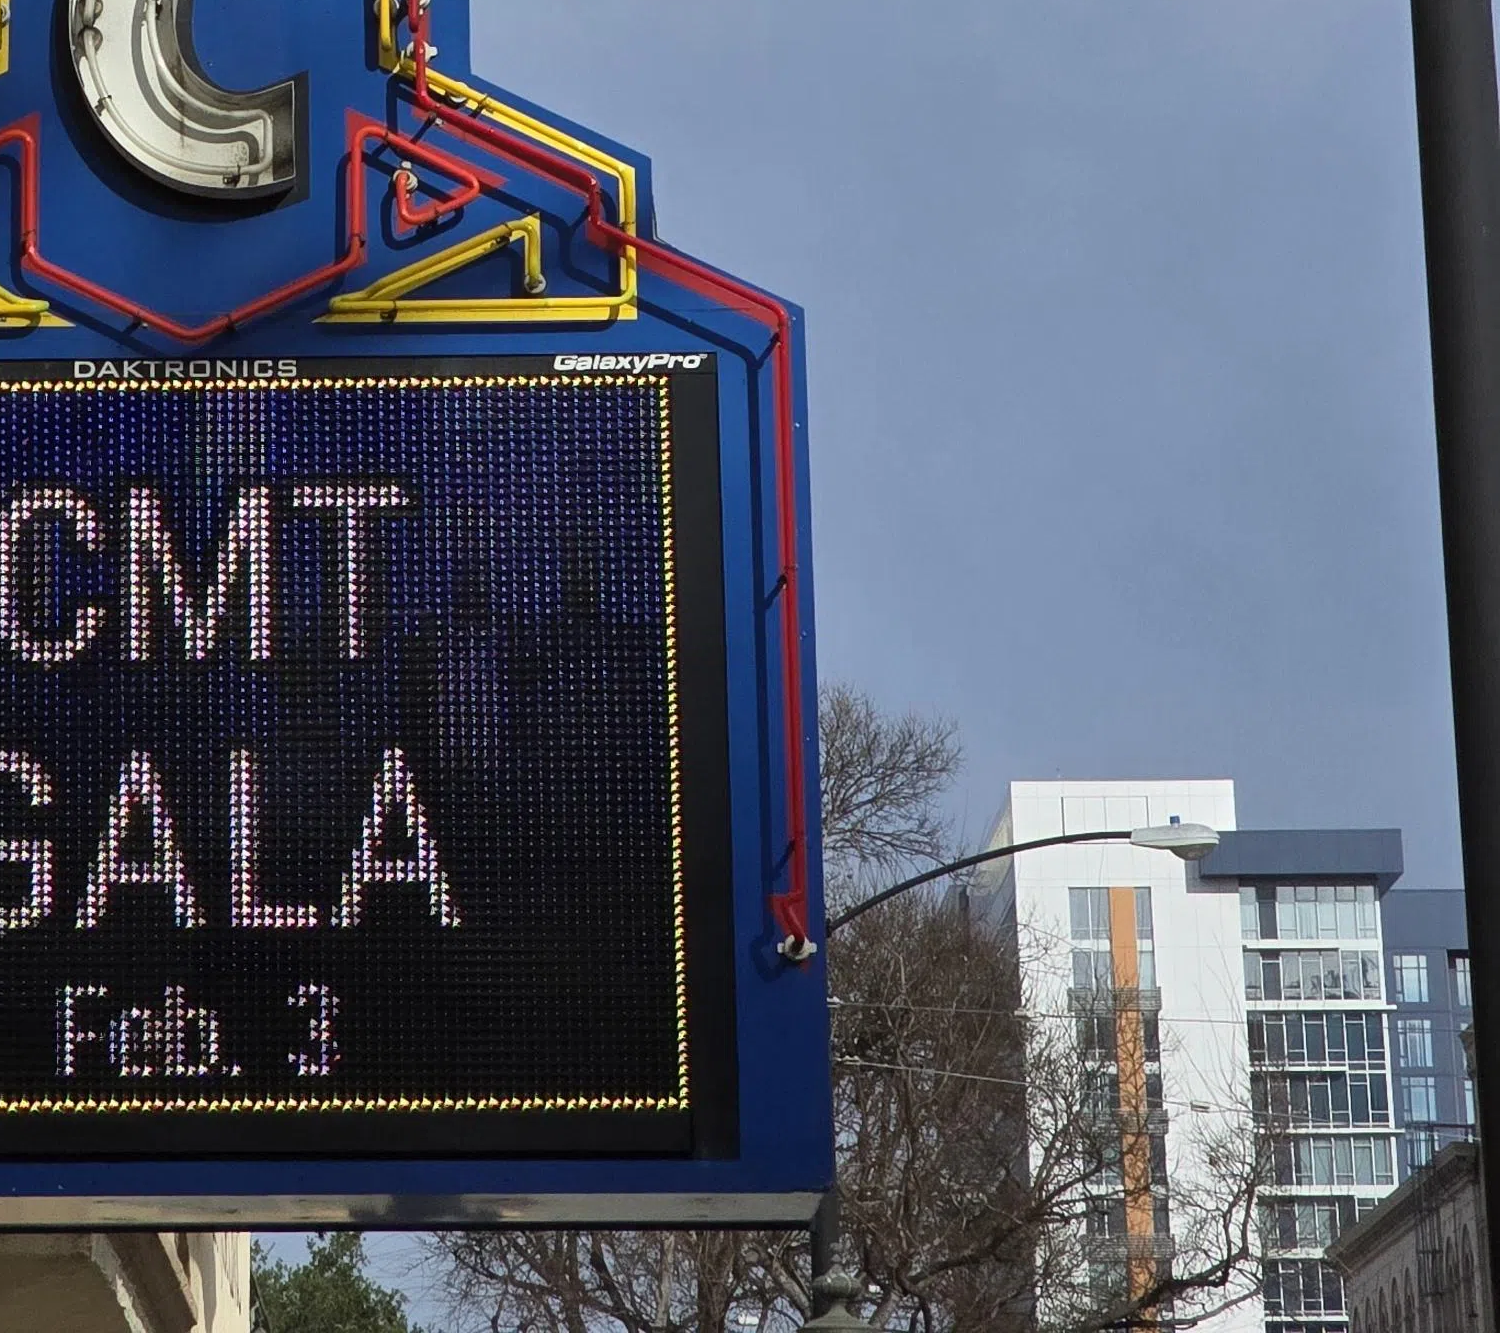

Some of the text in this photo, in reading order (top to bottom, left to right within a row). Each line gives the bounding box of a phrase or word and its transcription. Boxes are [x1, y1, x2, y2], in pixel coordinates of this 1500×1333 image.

[73, 359, 298, 379] DAKTRONICS
[55, 983, 340, 1077] Feb. 3
